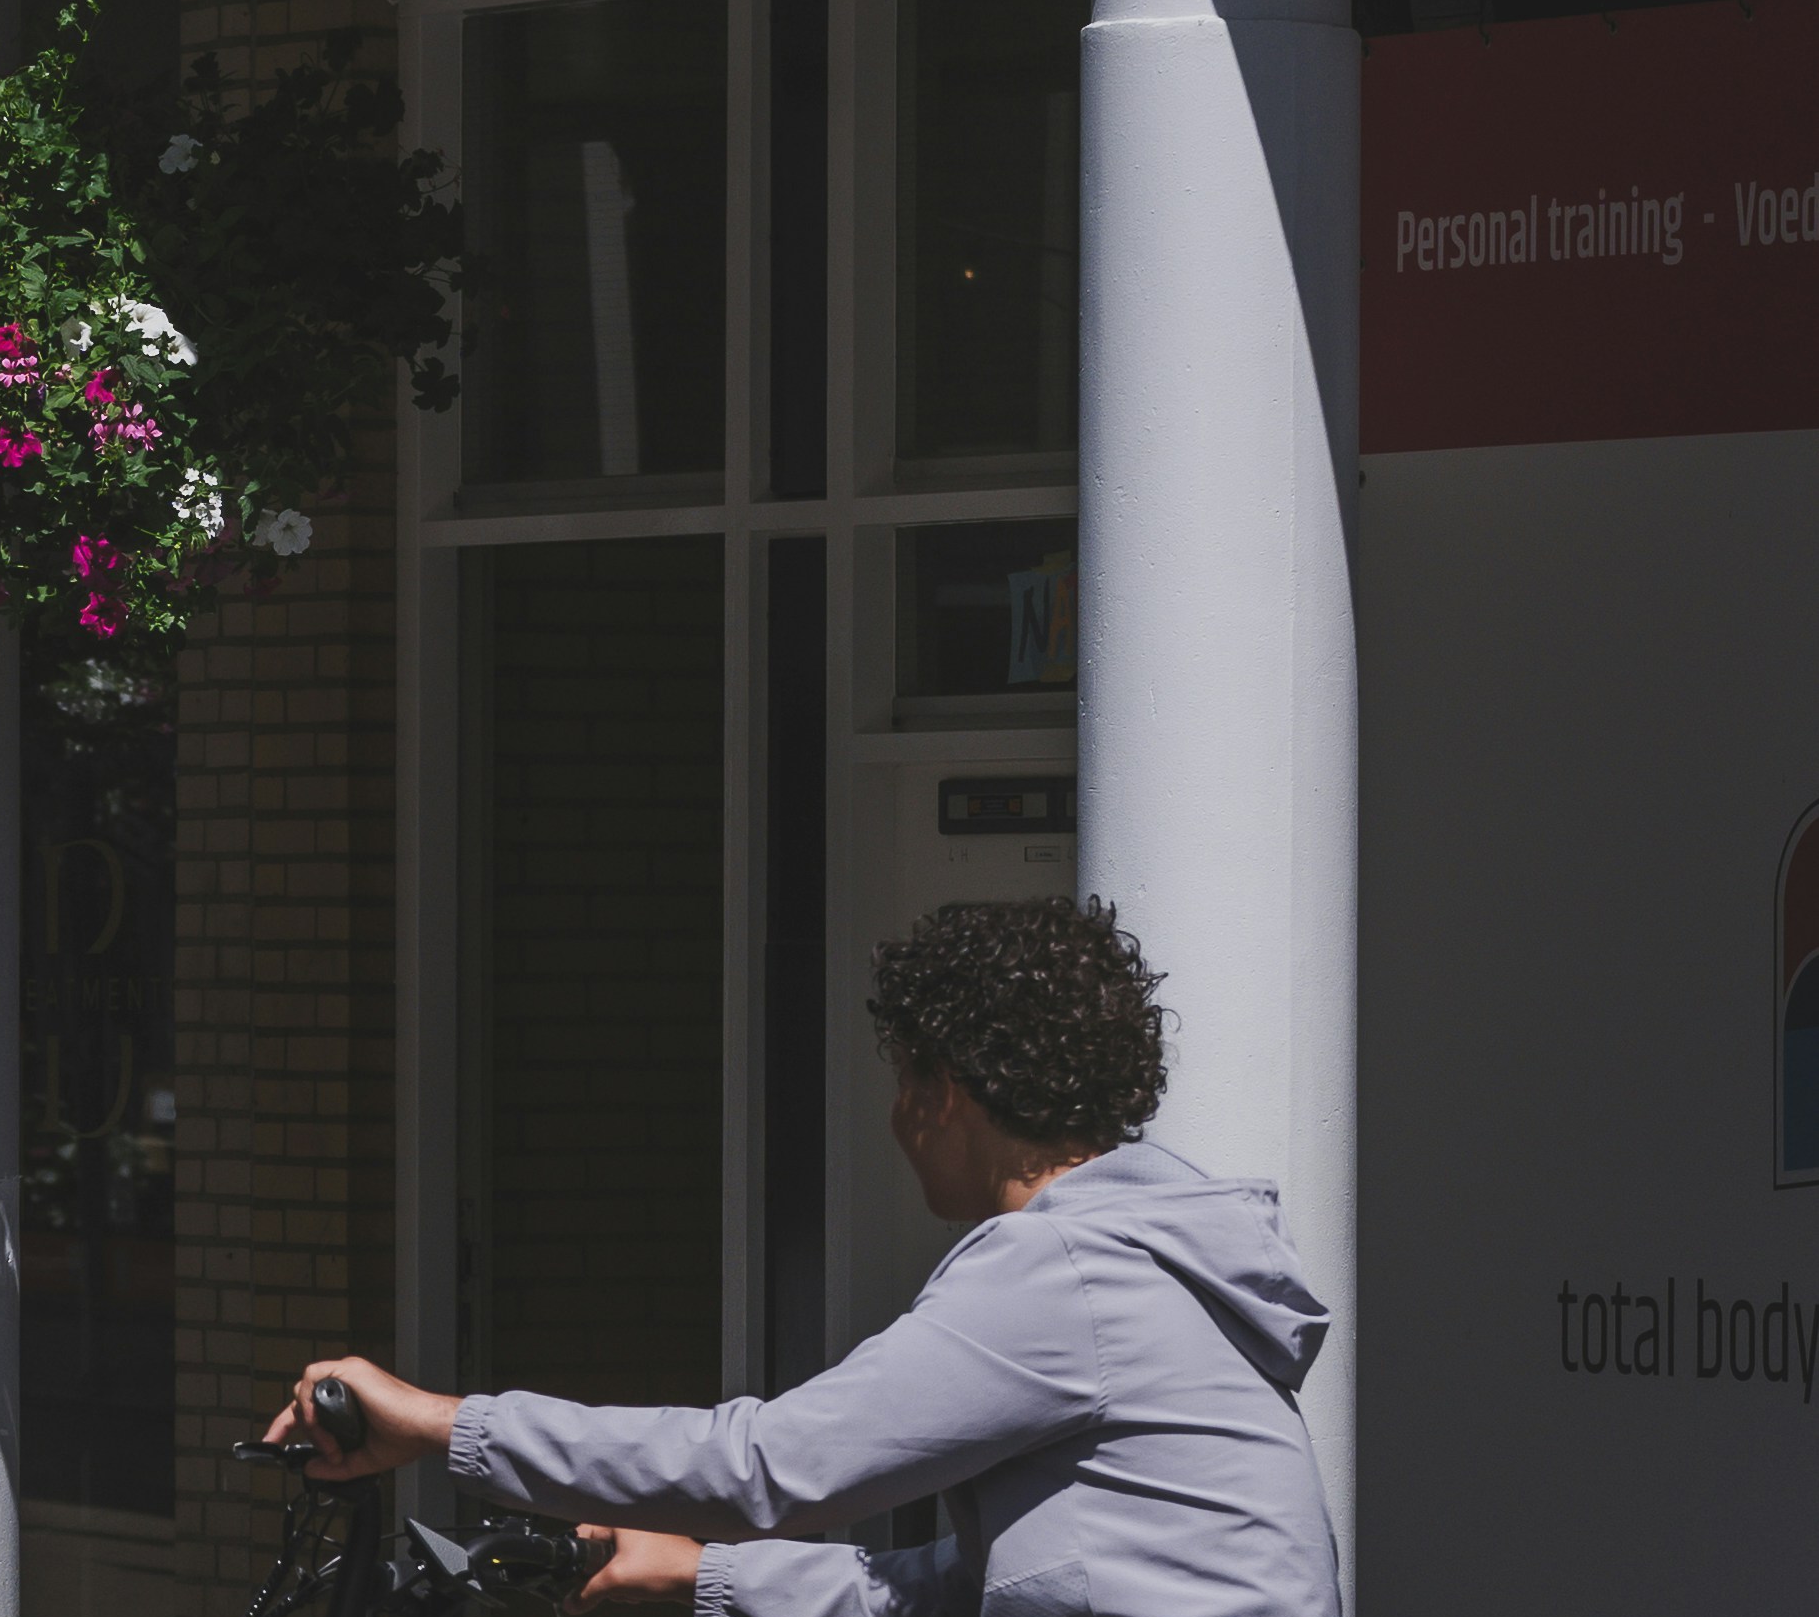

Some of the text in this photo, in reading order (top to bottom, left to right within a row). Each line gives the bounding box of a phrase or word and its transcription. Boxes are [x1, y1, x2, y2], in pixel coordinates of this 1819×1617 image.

[1396, 194, 1539, 273] Personal
[1547, 185, 1685, 266] training
[1734, 172, 1819, 248] Voed
[1018, 572, 1078, 663] NA
[1557, 1277, 1819, 1404] total body
